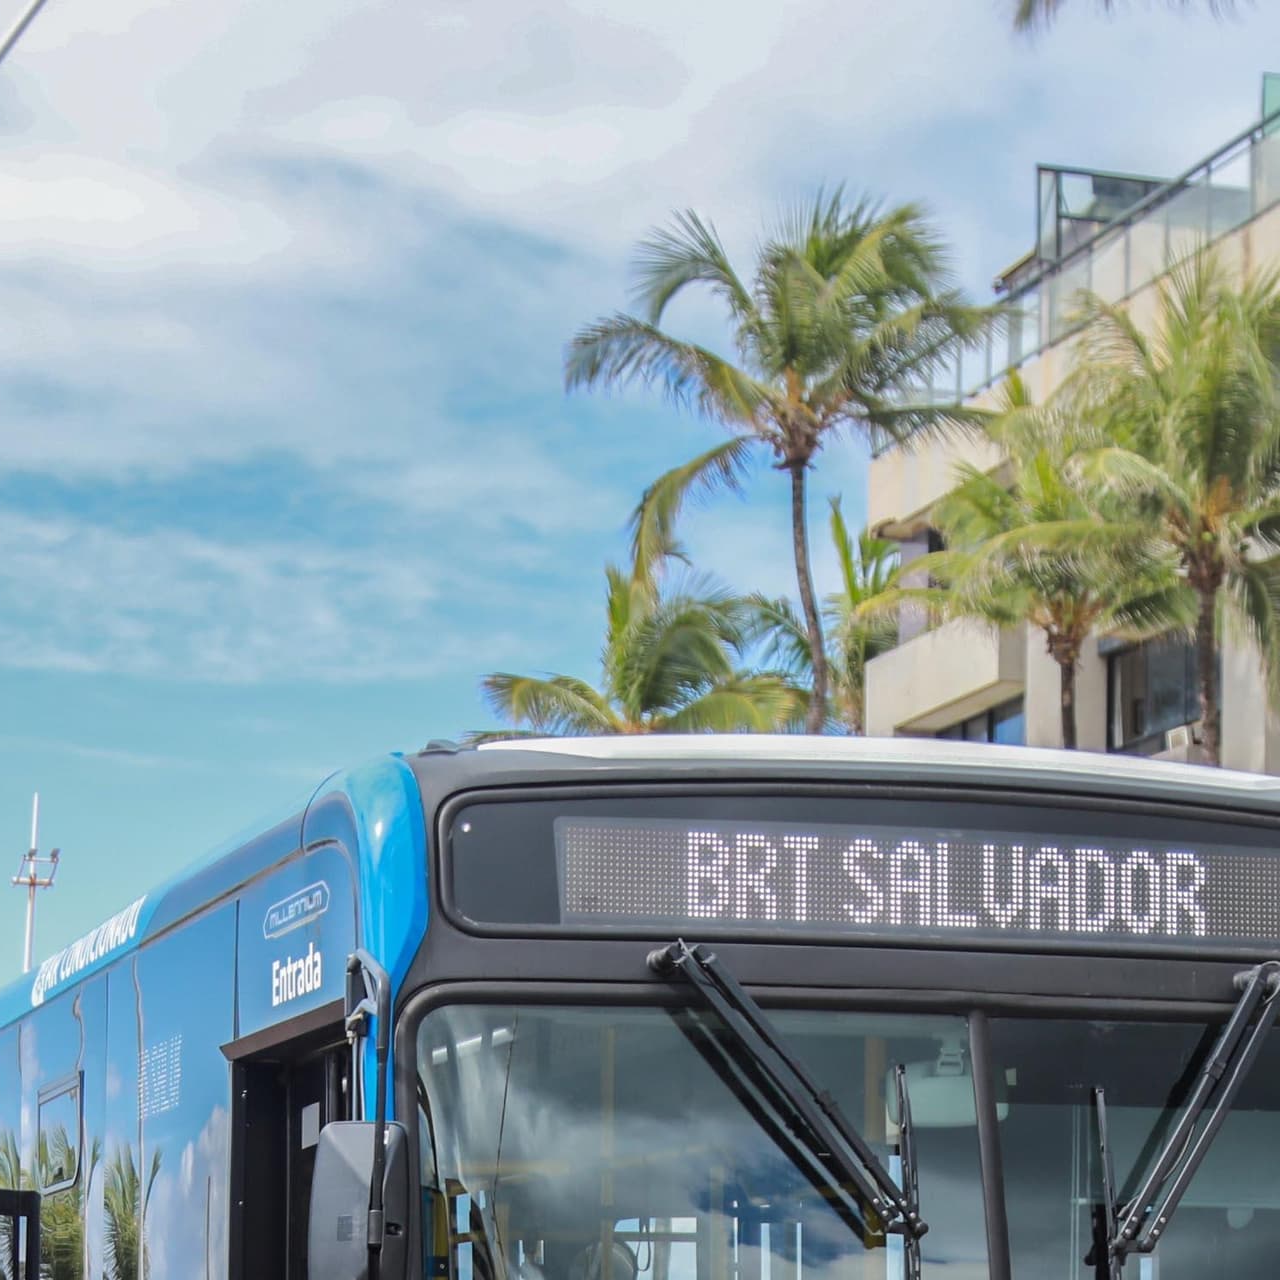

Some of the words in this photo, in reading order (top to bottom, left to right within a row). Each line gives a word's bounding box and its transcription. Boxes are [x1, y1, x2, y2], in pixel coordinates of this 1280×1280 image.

[687, 831, 819, 921] BRT
[842, 839, 1206, 937] SALVADOR
[271, 941, 322, 1007] Entrada
